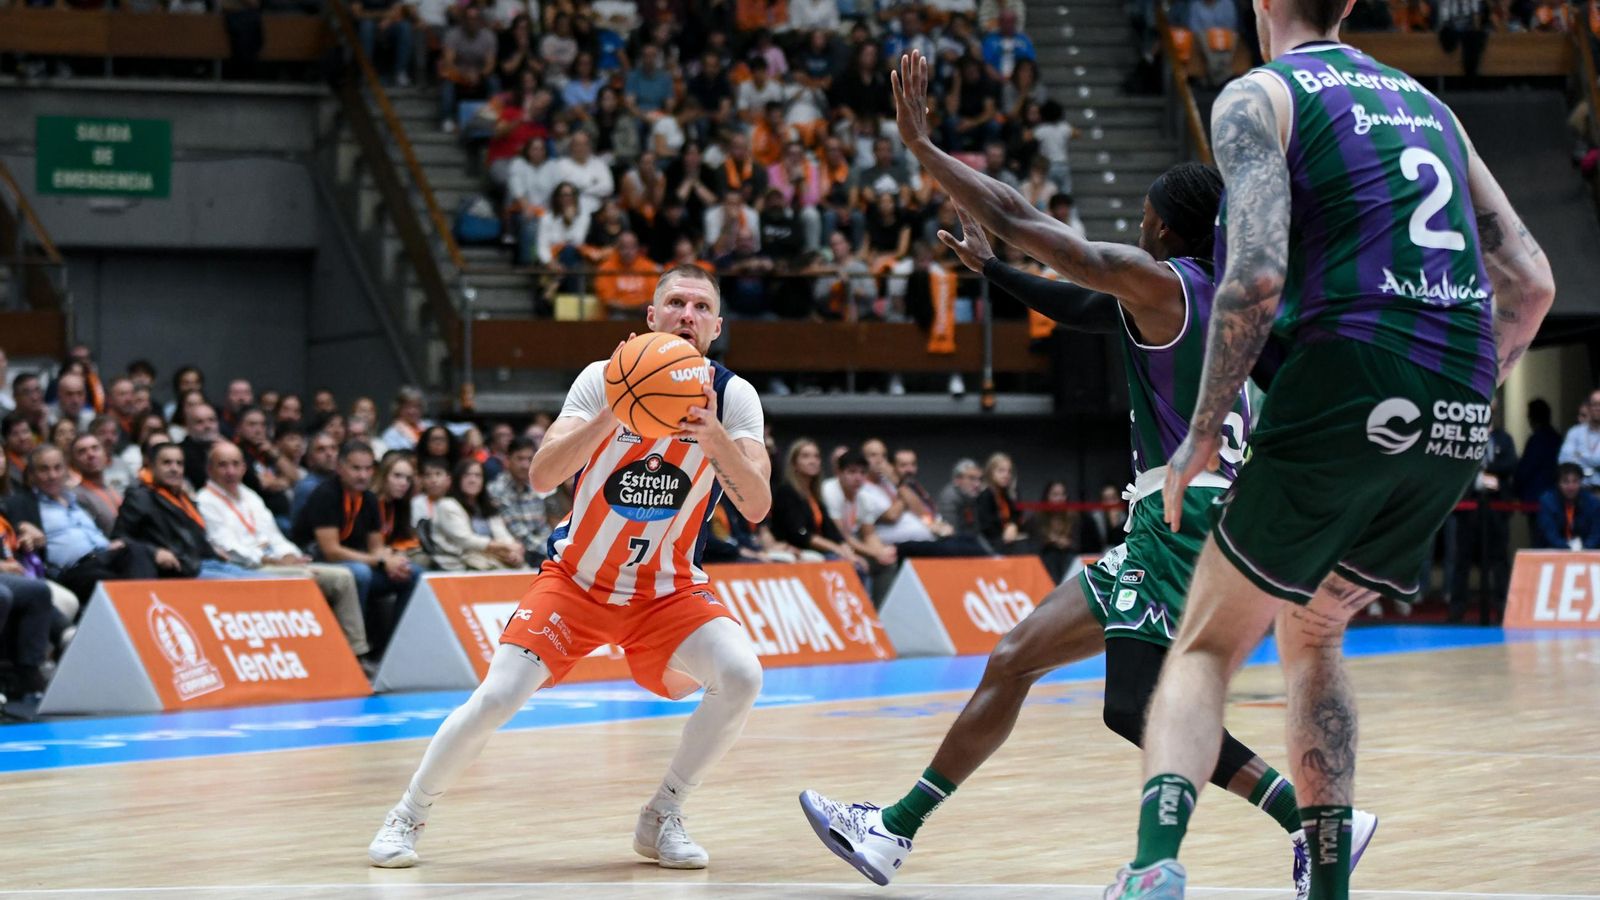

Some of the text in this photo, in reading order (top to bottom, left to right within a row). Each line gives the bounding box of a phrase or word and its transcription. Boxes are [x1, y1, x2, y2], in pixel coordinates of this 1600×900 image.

[1292, 64, 1432, 96] Balcerow
[76, 123, 132, 142] SALIDA
[93, 147, 113, 165] DE
[52, 171, 154, 190] EMERGENCIA
[1400, 148, 1466, 251] 2
[1430, 423, 1488, 442] DEL SO
[1425, 441, 1486, 460] MÁLAG
[619, 471, 679, 490] Estrella
[620, 487, 674, 506] Galicia
[626, 538, 650, 567] 7
[203, 604, 323, 649] Fagamos
[715, 578, 846, 656] LEYMA
[222, 643, 309, 682] lenda
